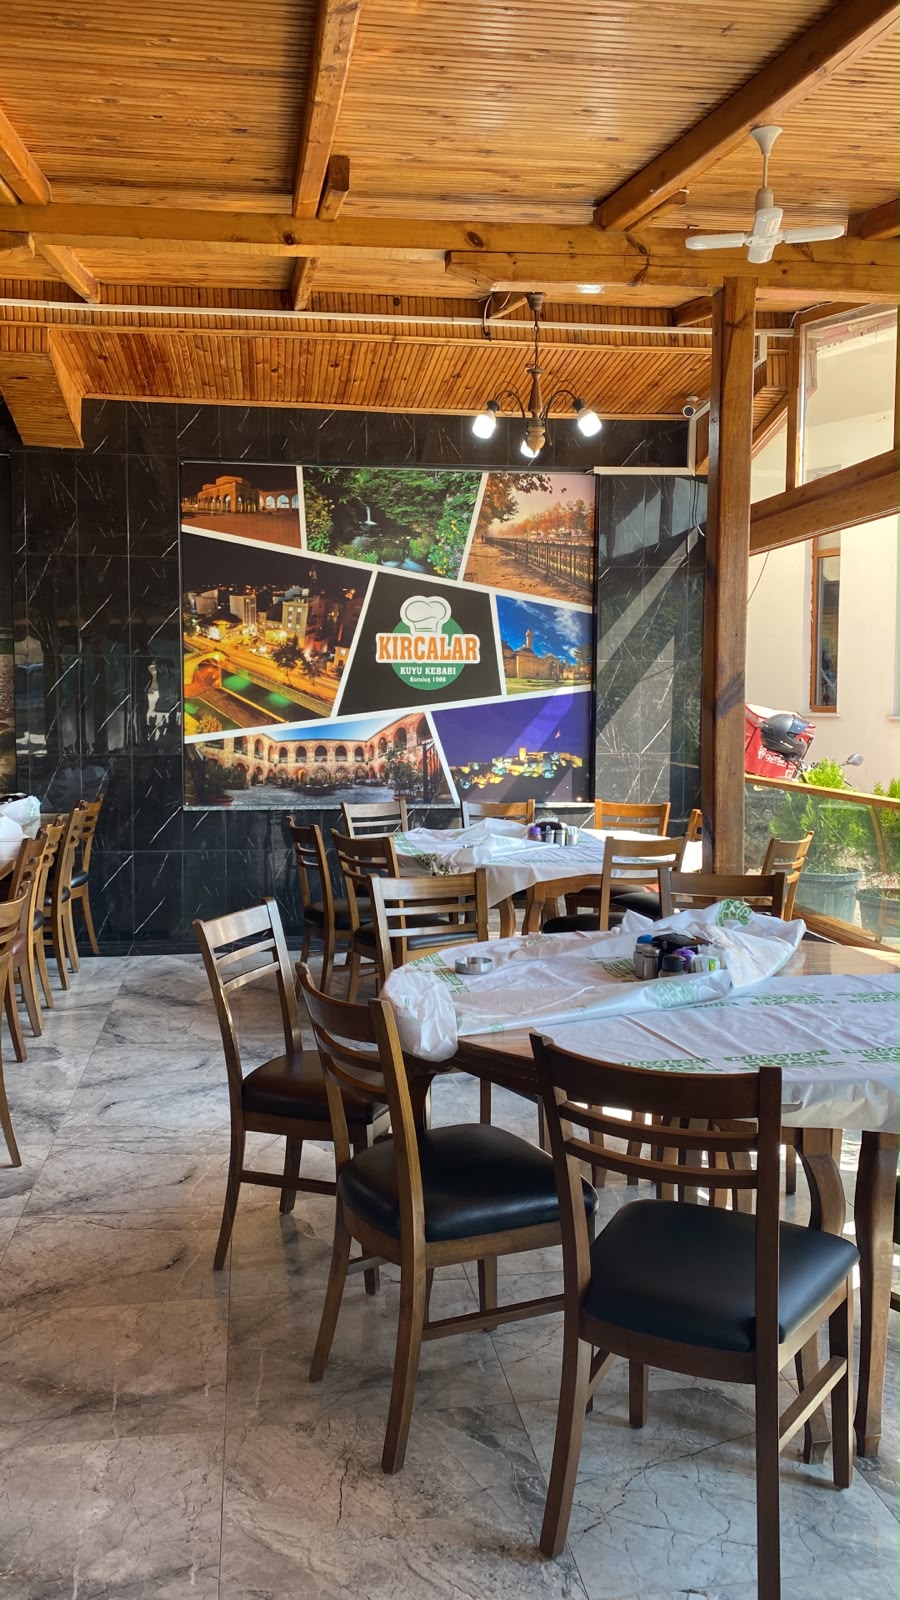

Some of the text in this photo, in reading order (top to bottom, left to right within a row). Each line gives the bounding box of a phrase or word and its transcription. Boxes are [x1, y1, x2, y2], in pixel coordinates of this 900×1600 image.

[378, 636, 478, 661] KIRCALAR
[400, 667, 456, 676] KUYU KEBABI
